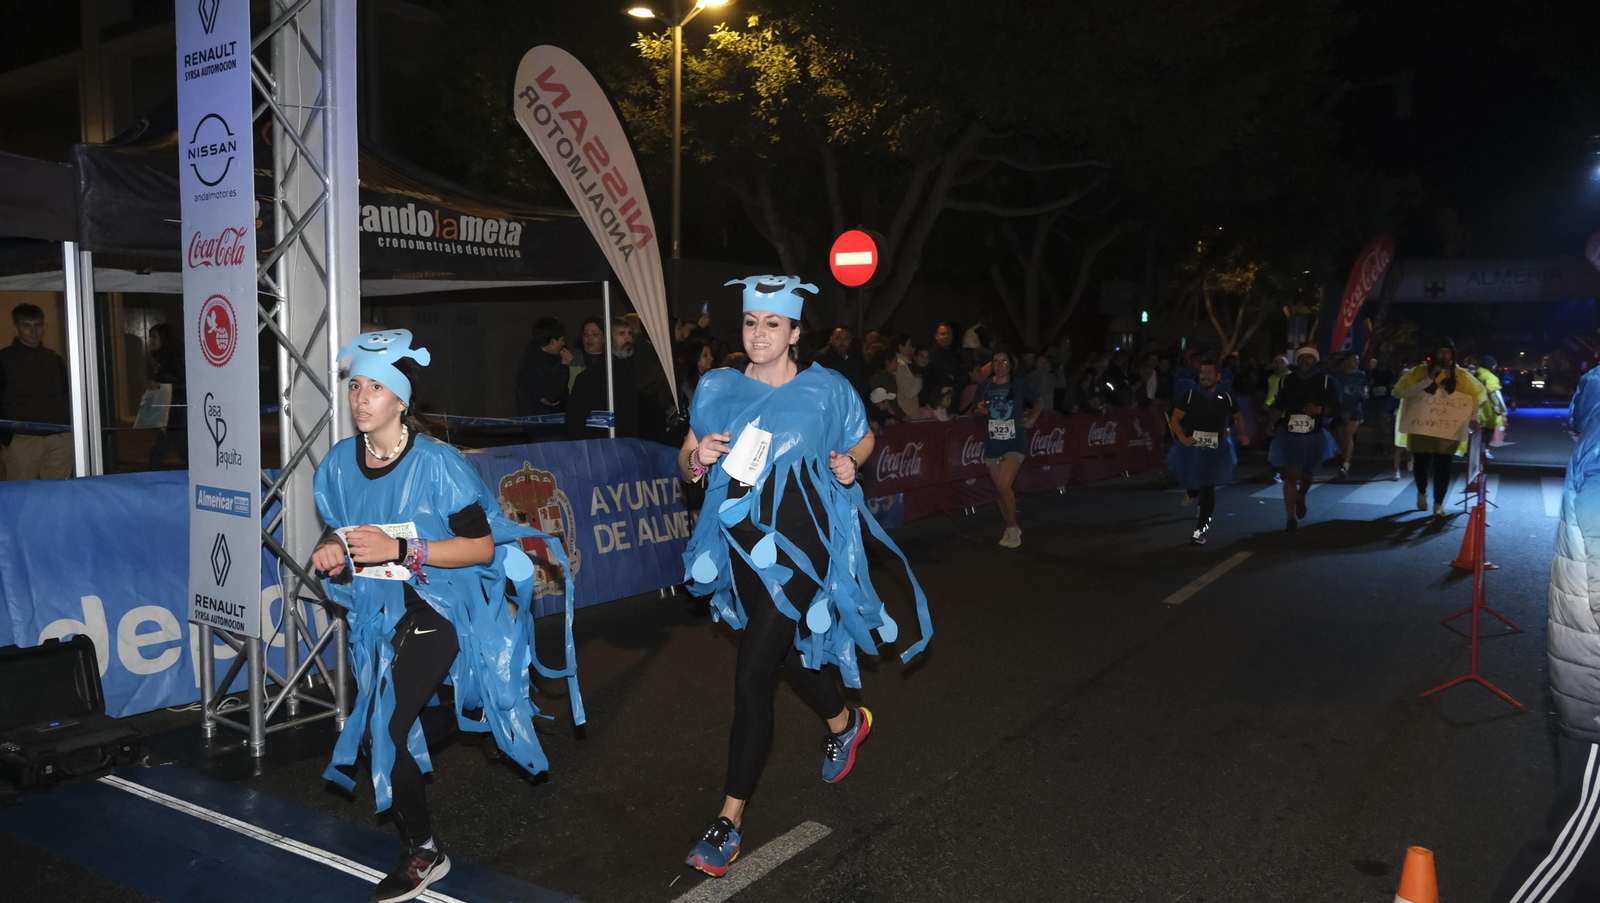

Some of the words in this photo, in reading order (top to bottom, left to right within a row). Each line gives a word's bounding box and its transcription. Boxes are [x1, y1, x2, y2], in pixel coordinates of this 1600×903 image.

[184, 41, 237, 68] RENAULT
[184, 66, 201, 81] SYRSA
[201, 59, 237, 77] AUTOMOCION
[188, 140, 237, 160] NISSAN
[194, 189, 237, 203] andalmotor.es
[188, 226, 248, 269] Coca-Cola
[378, 236, 464, 254] cronometraje
[466, 244, 522, 259] deportivo
[197, 489, 234, 511] Almericar
[590, 476, 684, 516] AYUNTA
[593, 521, 631, 554] DE
[195, 594, 246, 619] RENAULT
[195, 610, 209, 622] SYRSA
[210, 614, 245, 632] AUTOMOCION
